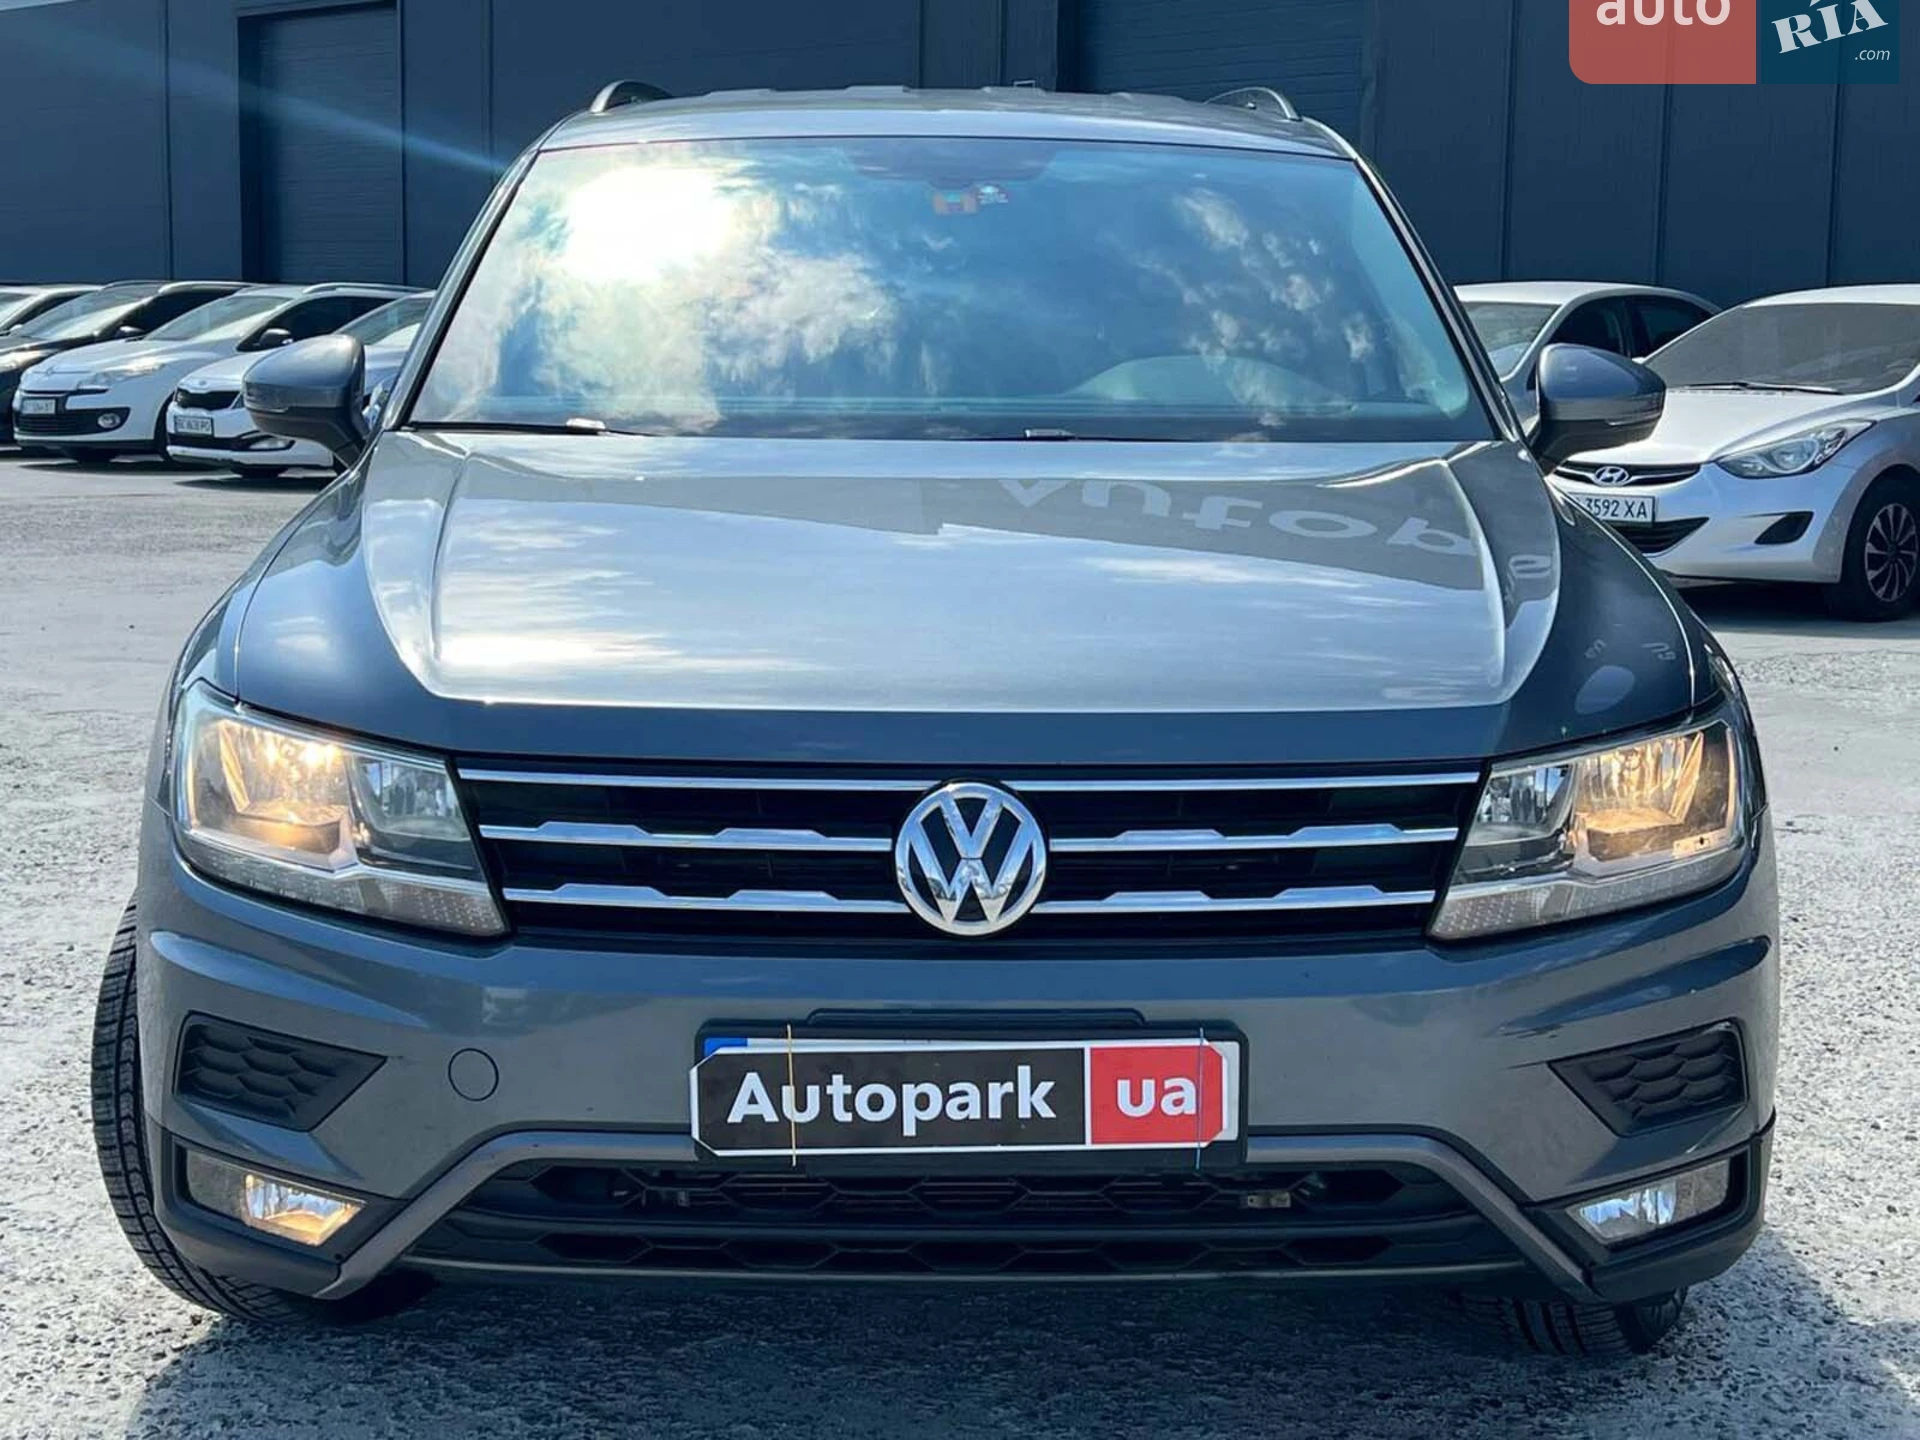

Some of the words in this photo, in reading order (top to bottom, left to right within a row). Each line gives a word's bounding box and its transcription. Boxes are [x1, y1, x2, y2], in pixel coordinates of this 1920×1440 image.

[1585, 497, 1620, 517] 3592
[1624, 500, 1647, 518] XA
[727, 1065, 1056, 1136] Autopark
[1117, 1077, 1197, 1117] ua
